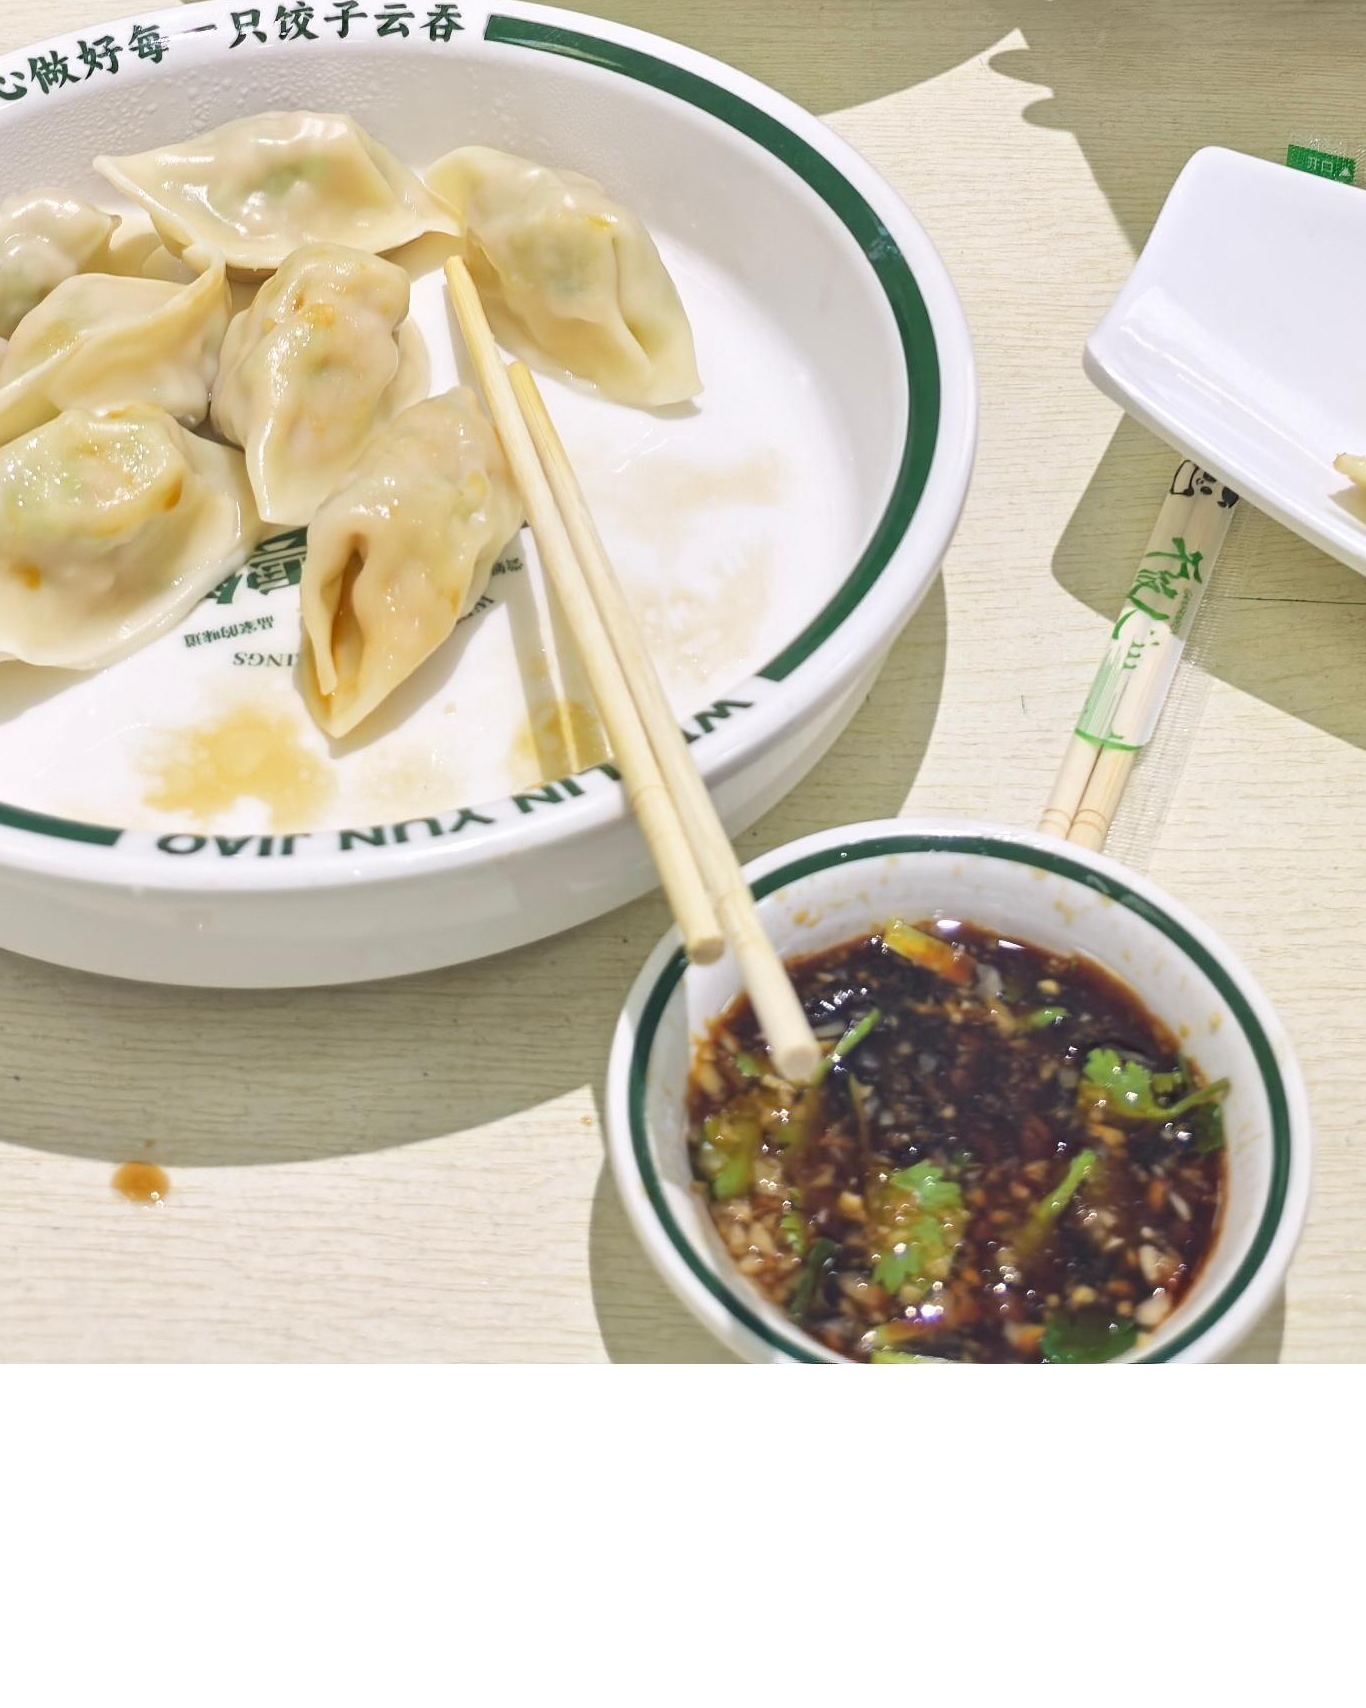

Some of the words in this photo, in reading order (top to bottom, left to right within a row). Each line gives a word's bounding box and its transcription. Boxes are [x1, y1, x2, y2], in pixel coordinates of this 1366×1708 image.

[233, 652, 299, 668] INGS
[339, 807, 495, 851] YUN
[156, 832, 312, 857] JIAO
